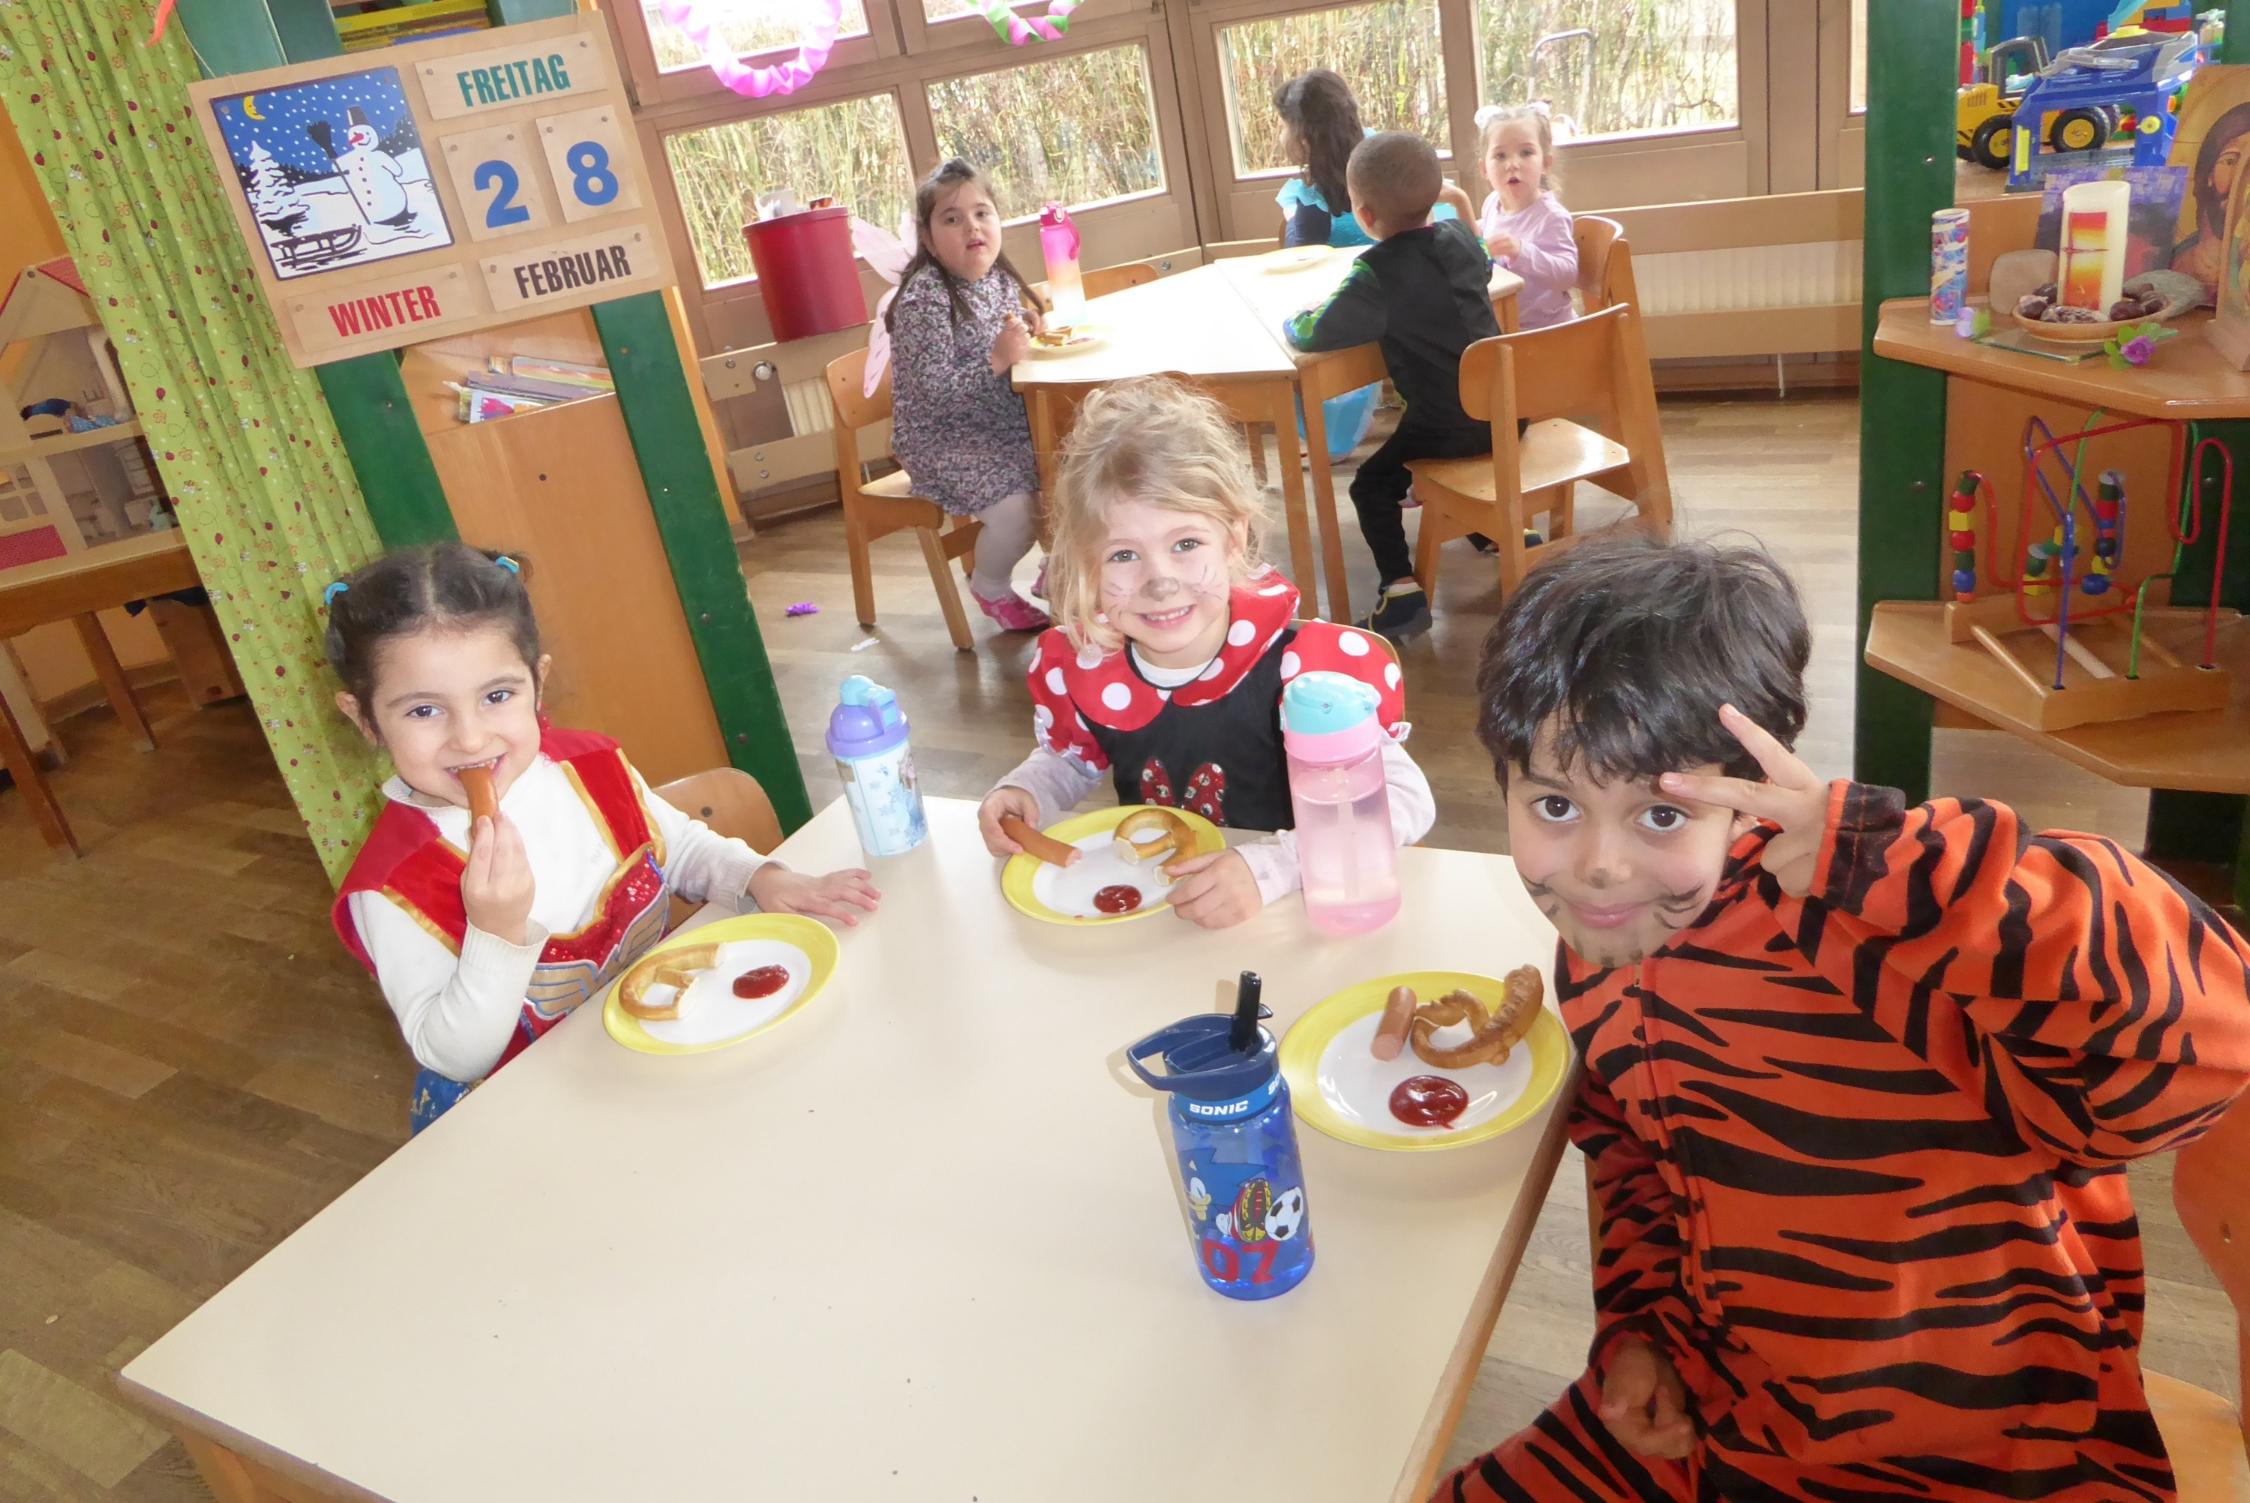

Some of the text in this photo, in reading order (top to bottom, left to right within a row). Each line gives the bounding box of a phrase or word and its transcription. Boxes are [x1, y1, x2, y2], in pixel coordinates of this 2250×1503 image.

[456, 53, 571, 107] FREITAG
[473, 140, 619, 229] 2 8
[513, 244, 632, 299] FEBRUAR
[327, 285, 442, 338] WINTER
[1189, 1100, 1249, 1116] SONIC
[1202, 1238, 1279, 1285] 07
